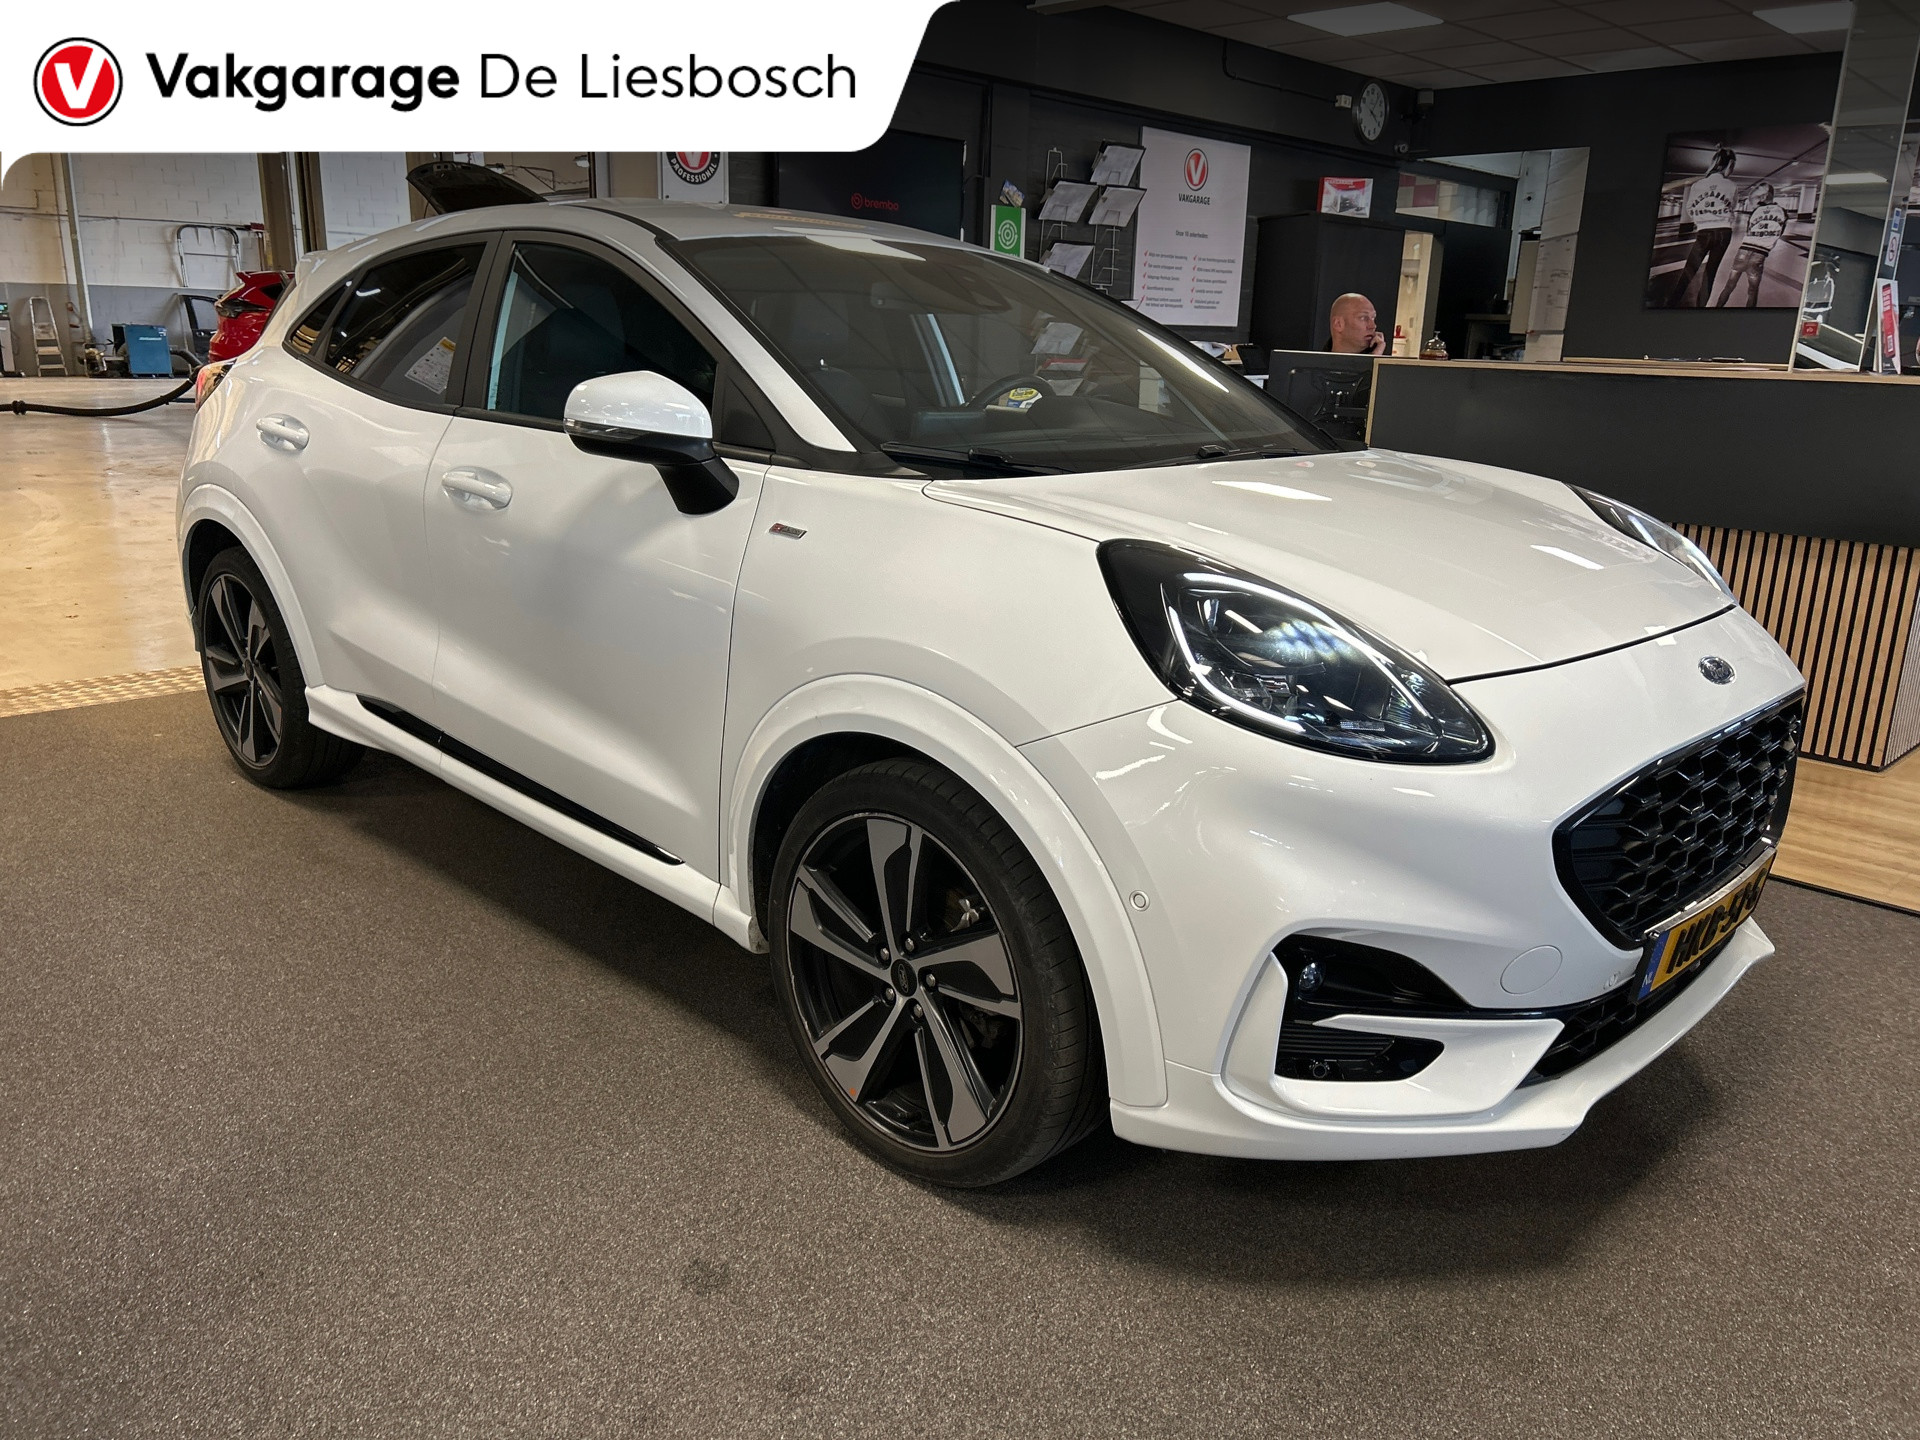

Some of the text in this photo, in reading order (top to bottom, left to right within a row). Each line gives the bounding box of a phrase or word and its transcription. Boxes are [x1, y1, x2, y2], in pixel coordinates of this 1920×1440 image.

[671, 158, 717, 183] PROFESSIONAL
[864, 196, 899, 211] brembo
[1178, 193, 1210, 206] VAKGARAGE
